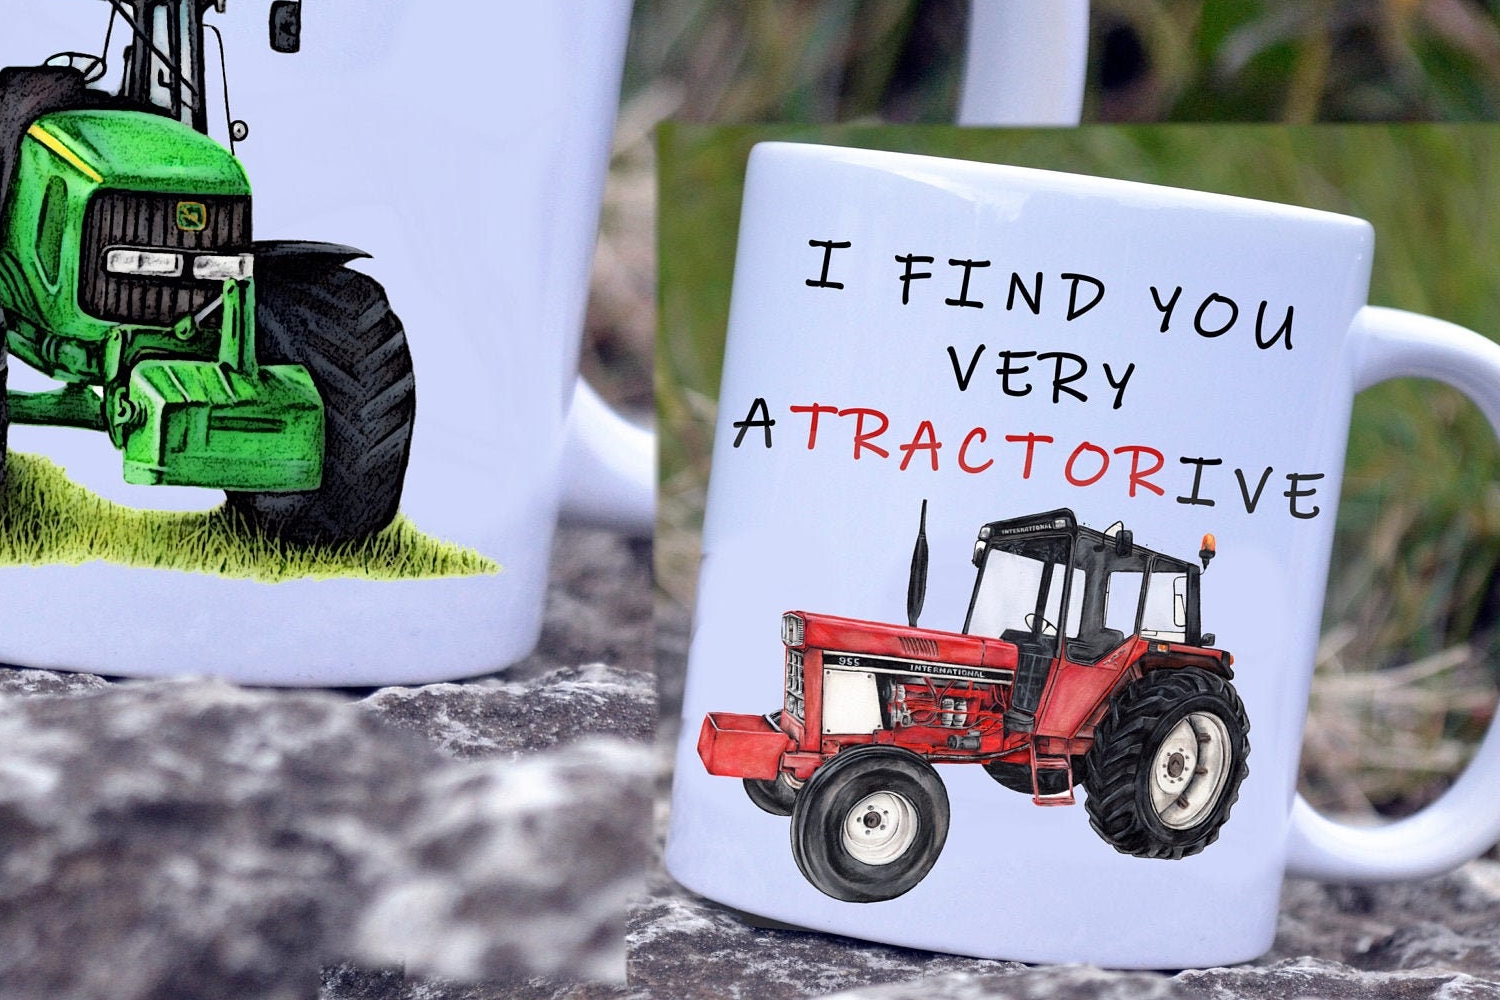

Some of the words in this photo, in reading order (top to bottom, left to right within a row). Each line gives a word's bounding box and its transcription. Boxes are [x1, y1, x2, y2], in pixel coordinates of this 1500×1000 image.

[806, 240, 851, 289] I
[895, 254, 1105, 321] FIND
[1150, 286, 1294, 350] YOU
[947, 344, 1135, 409] VERY
[733, 398, 1324, 519] ATRACTORIVE
[1001, 523, 1052, 535] INTERNATIONAL
[838, 656, 860, 667] 955
[910, 664, 985, 678] INTERNATIONAL
